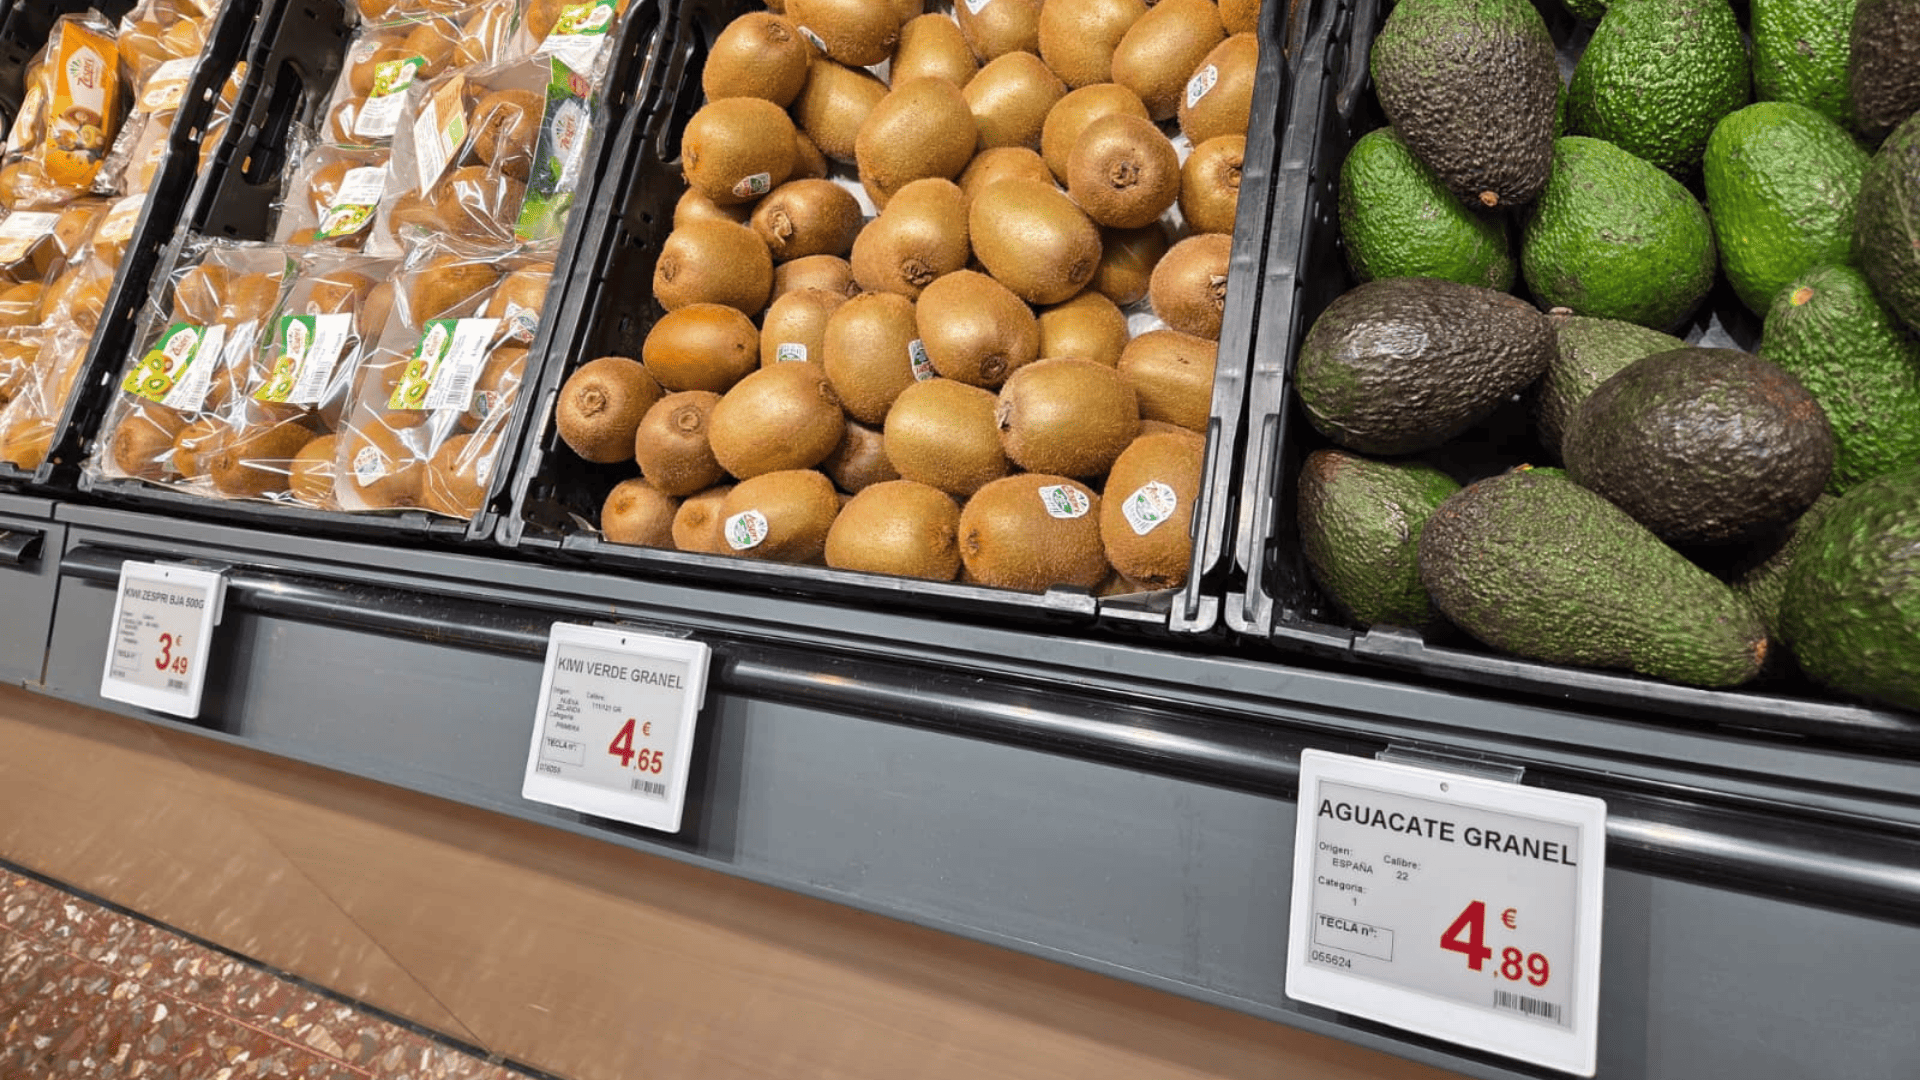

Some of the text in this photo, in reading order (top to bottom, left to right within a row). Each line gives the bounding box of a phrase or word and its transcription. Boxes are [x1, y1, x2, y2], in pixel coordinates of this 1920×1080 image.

[142, 589, 168, 604] ZESPRI
[169, 594, 185, 606] BJA
[185, 596, 205, 610] 500G
[558, 656, 685, 691] KIWI VERDE GRANEL
[642, 721, 652, 737] €
[1318, 798, 1577, 867] AGUACATE GRANEL
[1319, 841, 1354, 856] Origen:
[1332, 857, 1374, 875] ESPAÑA
[1383, 854, 1422, 870] Calibre:
[1396, 870, 1409, 881] 22
[1319, 915, 1359, 934] TECLA
[1501, 908, 1518, 930] €
